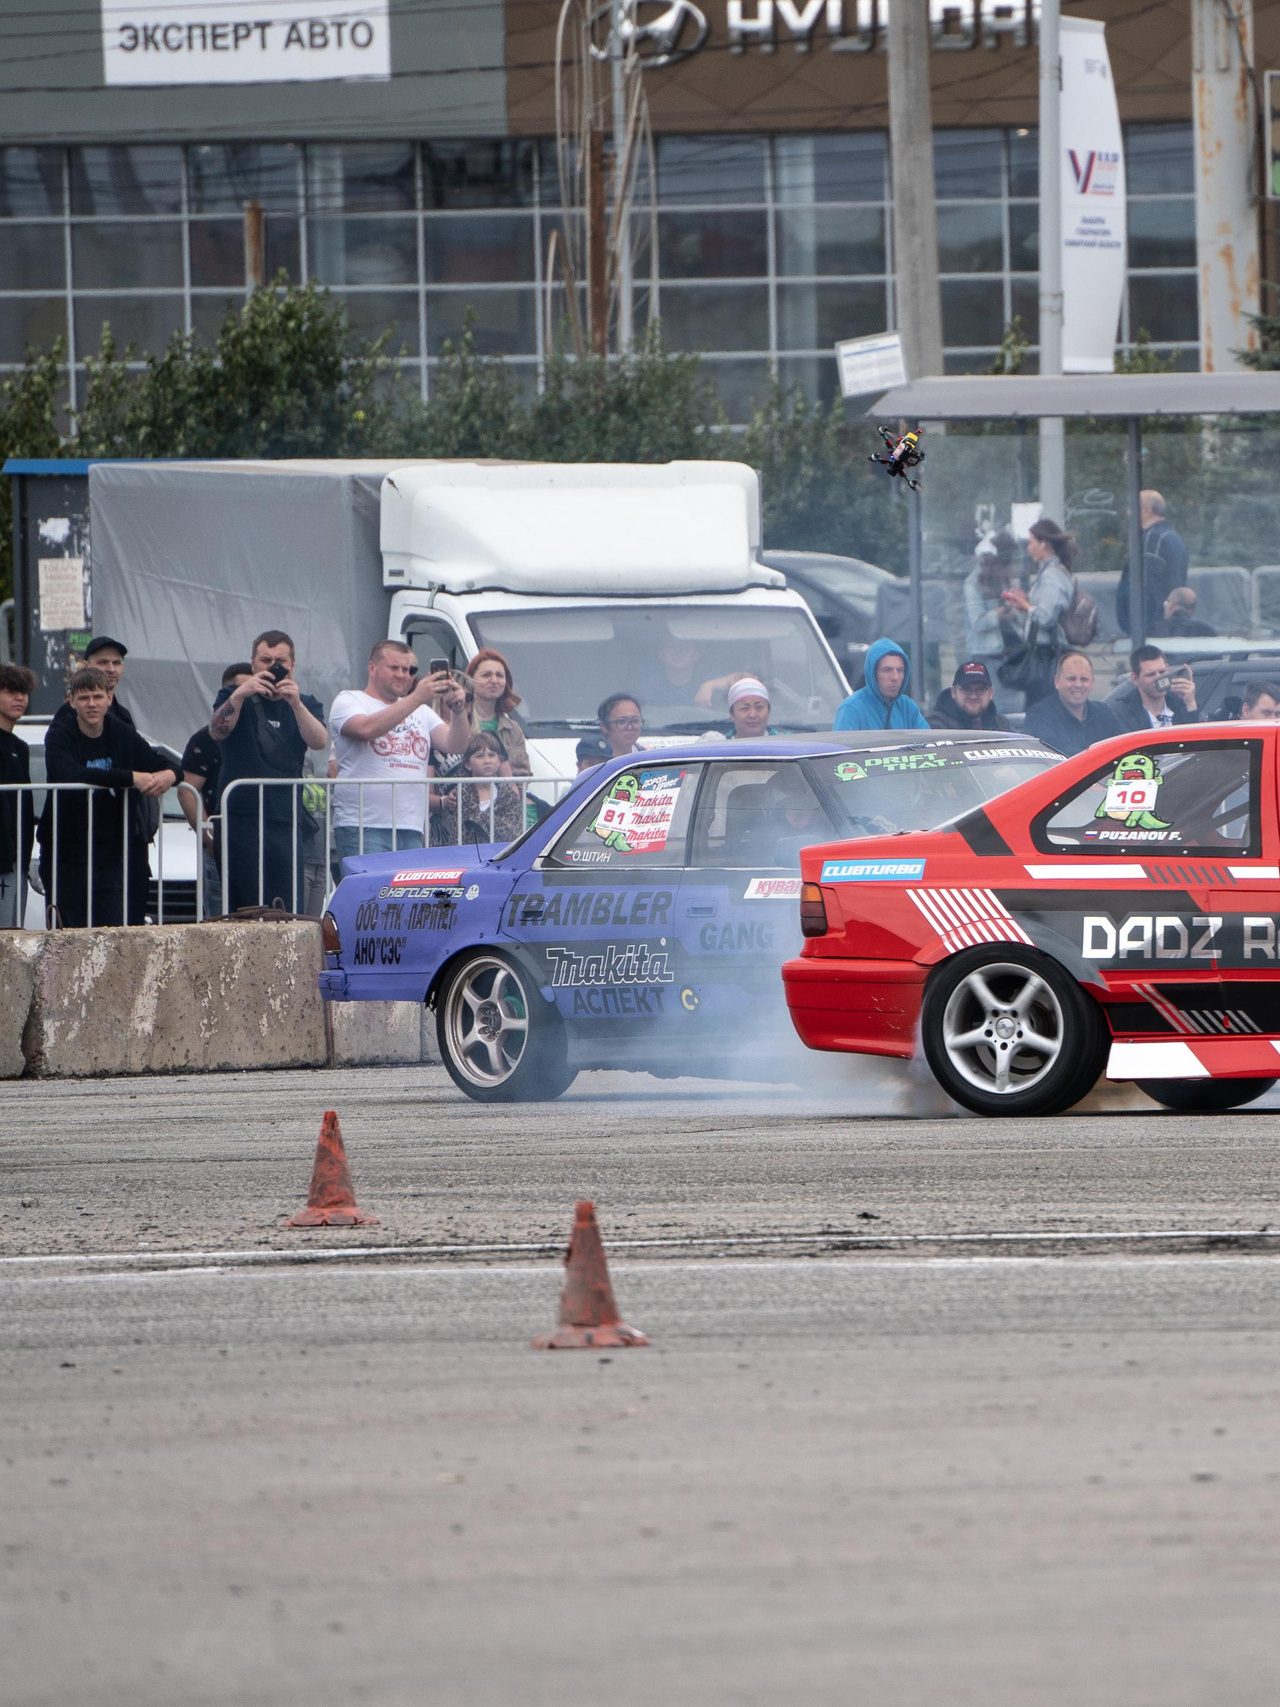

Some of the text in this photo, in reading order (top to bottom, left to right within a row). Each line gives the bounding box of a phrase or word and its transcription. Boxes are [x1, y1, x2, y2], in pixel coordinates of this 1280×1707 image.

[118, 19, 374, 52] ЭКСПЕРТ АВТО
[865, 753, 937, 767] DRIFT
[1116, 790, 1146, 804] 10
[603, 809, 626, 825] 81
[1098, 831, 1182, 841] PUZANOV F.
[572, 850, 612, 862] О.ШТИН
[393, 871, 462, 882] CLUBTURBO
[823, 864, 922, 877] CLUBTURBO
[355, 902, 379, 931] ООО
[507, 891, 673, 928] TRAMBLER
[700, 920, 774, 950] GANG
[1081, 916, 1223, 959] DADZ
[572, 987, 666, 1015] АСПЕКТ
